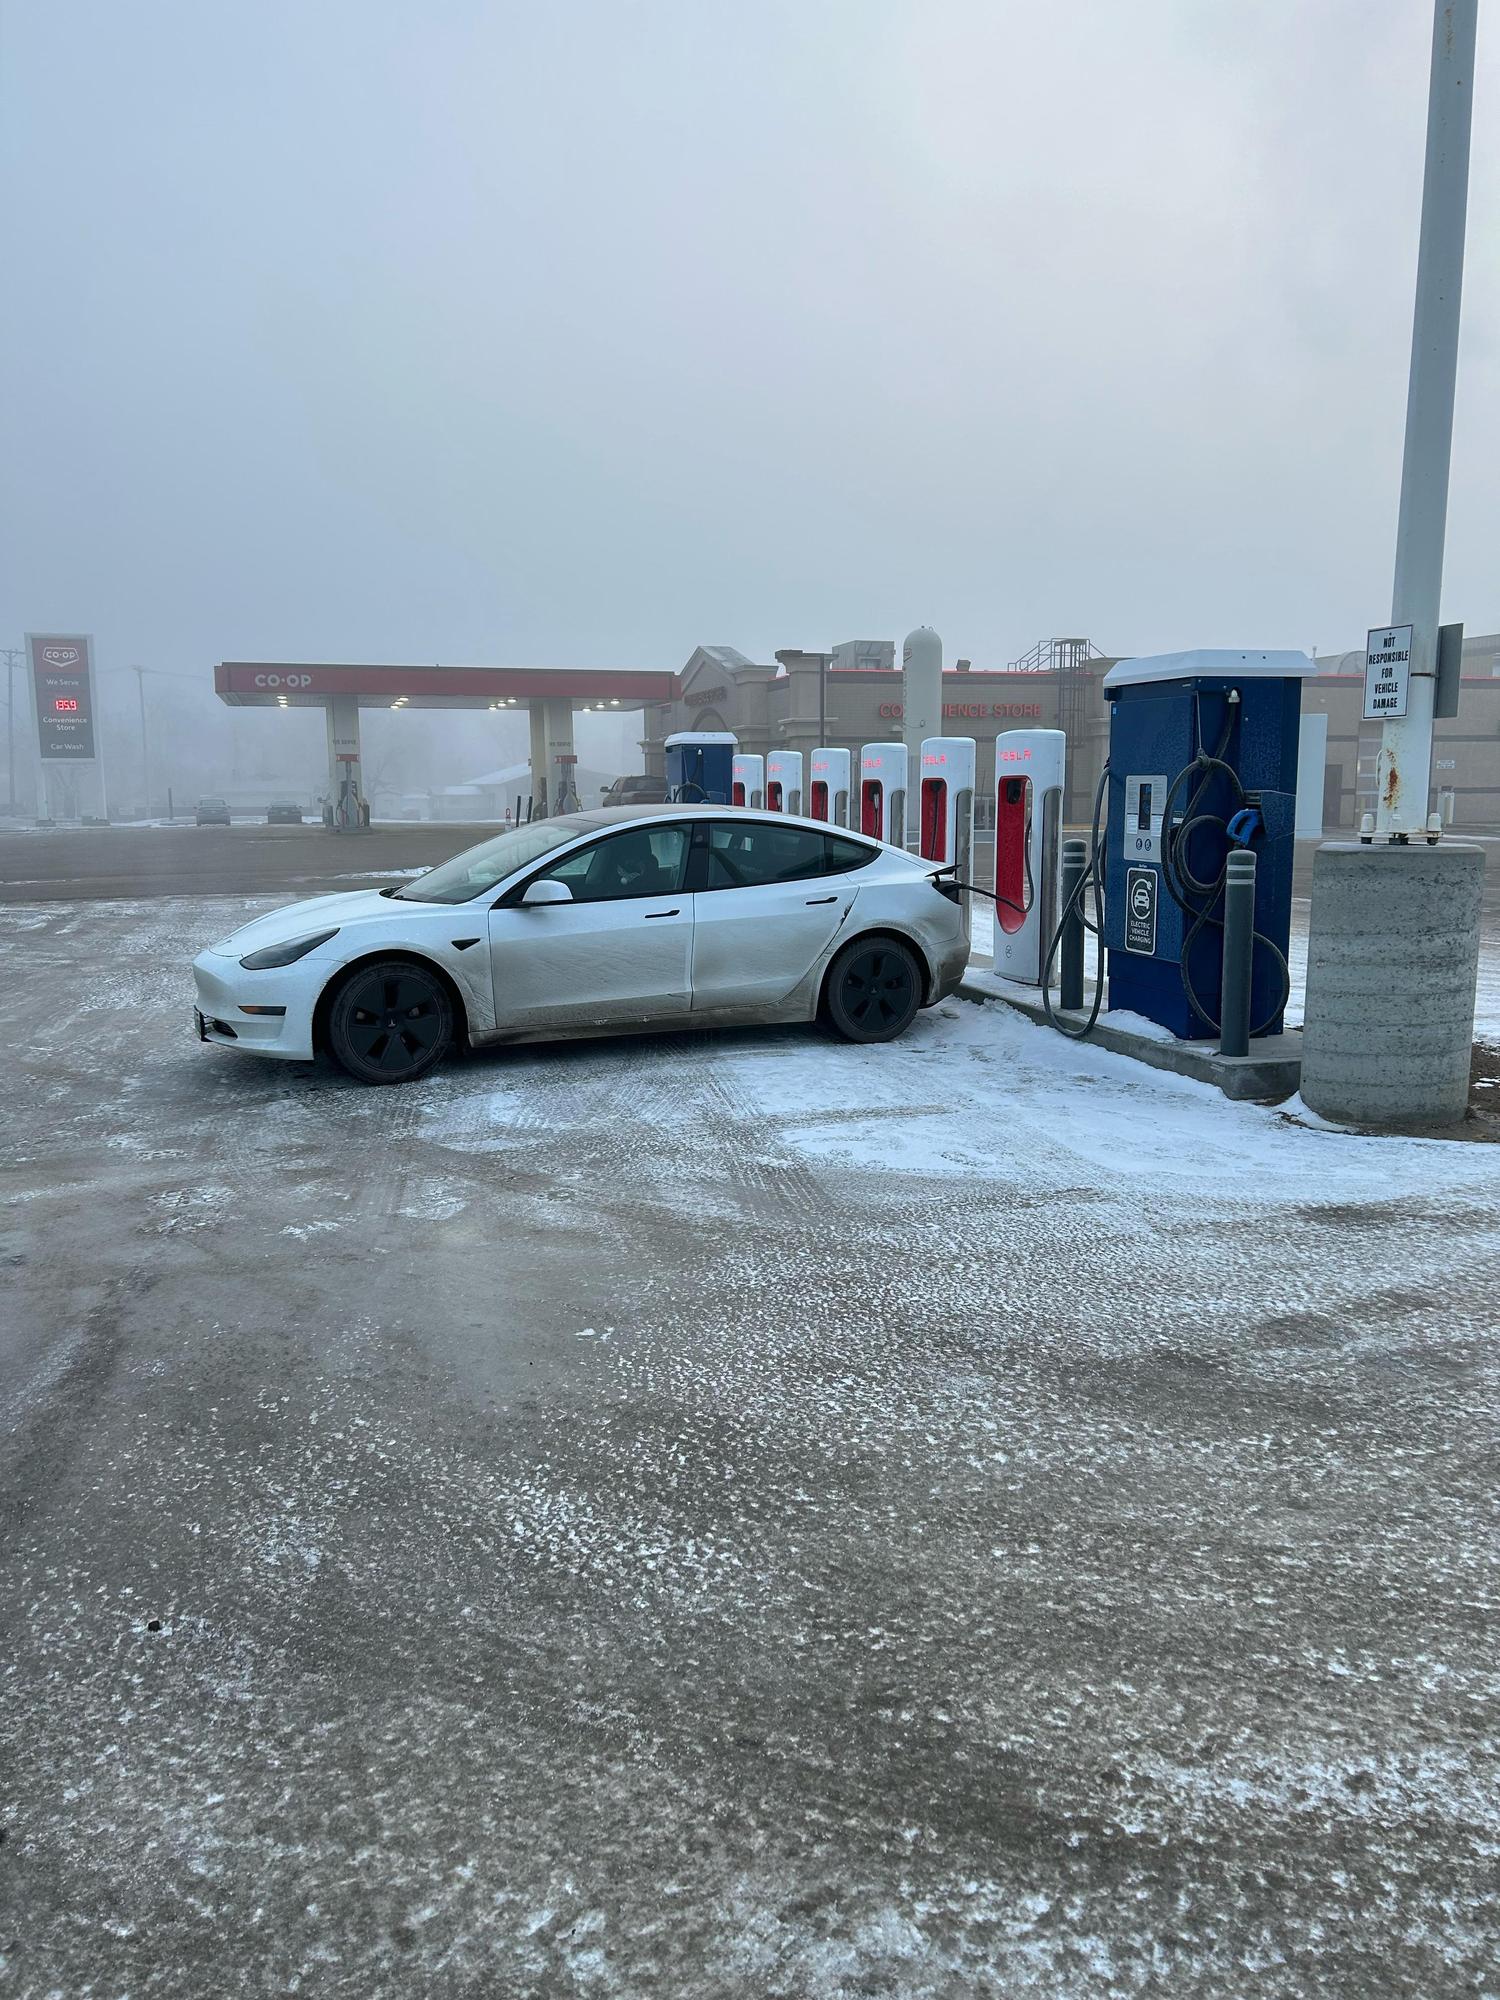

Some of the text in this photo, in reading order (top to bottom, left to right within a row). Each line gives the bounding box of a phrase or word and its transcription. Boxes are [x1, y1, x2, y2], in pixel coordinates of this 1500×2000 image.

[1383, 636, 1396, 649] NOT
[1368, 650, 1409, 665] RESPONSIBLE
[1381, 667, 1393, 679] FOR
[1374, 682, 1399, 694] VEHICLE
[1372, 697, 1398, 709] DAMAGE
[879, 703, 1041, 718] COIENCE STORE
[42, 716, 88, 724] Convenience
[1130, 920, 1151, 930] ELECTRIC
[1131, 928, 1149, 937] VEHICLE
[1128, 934, 1152, 945] CHARGING
